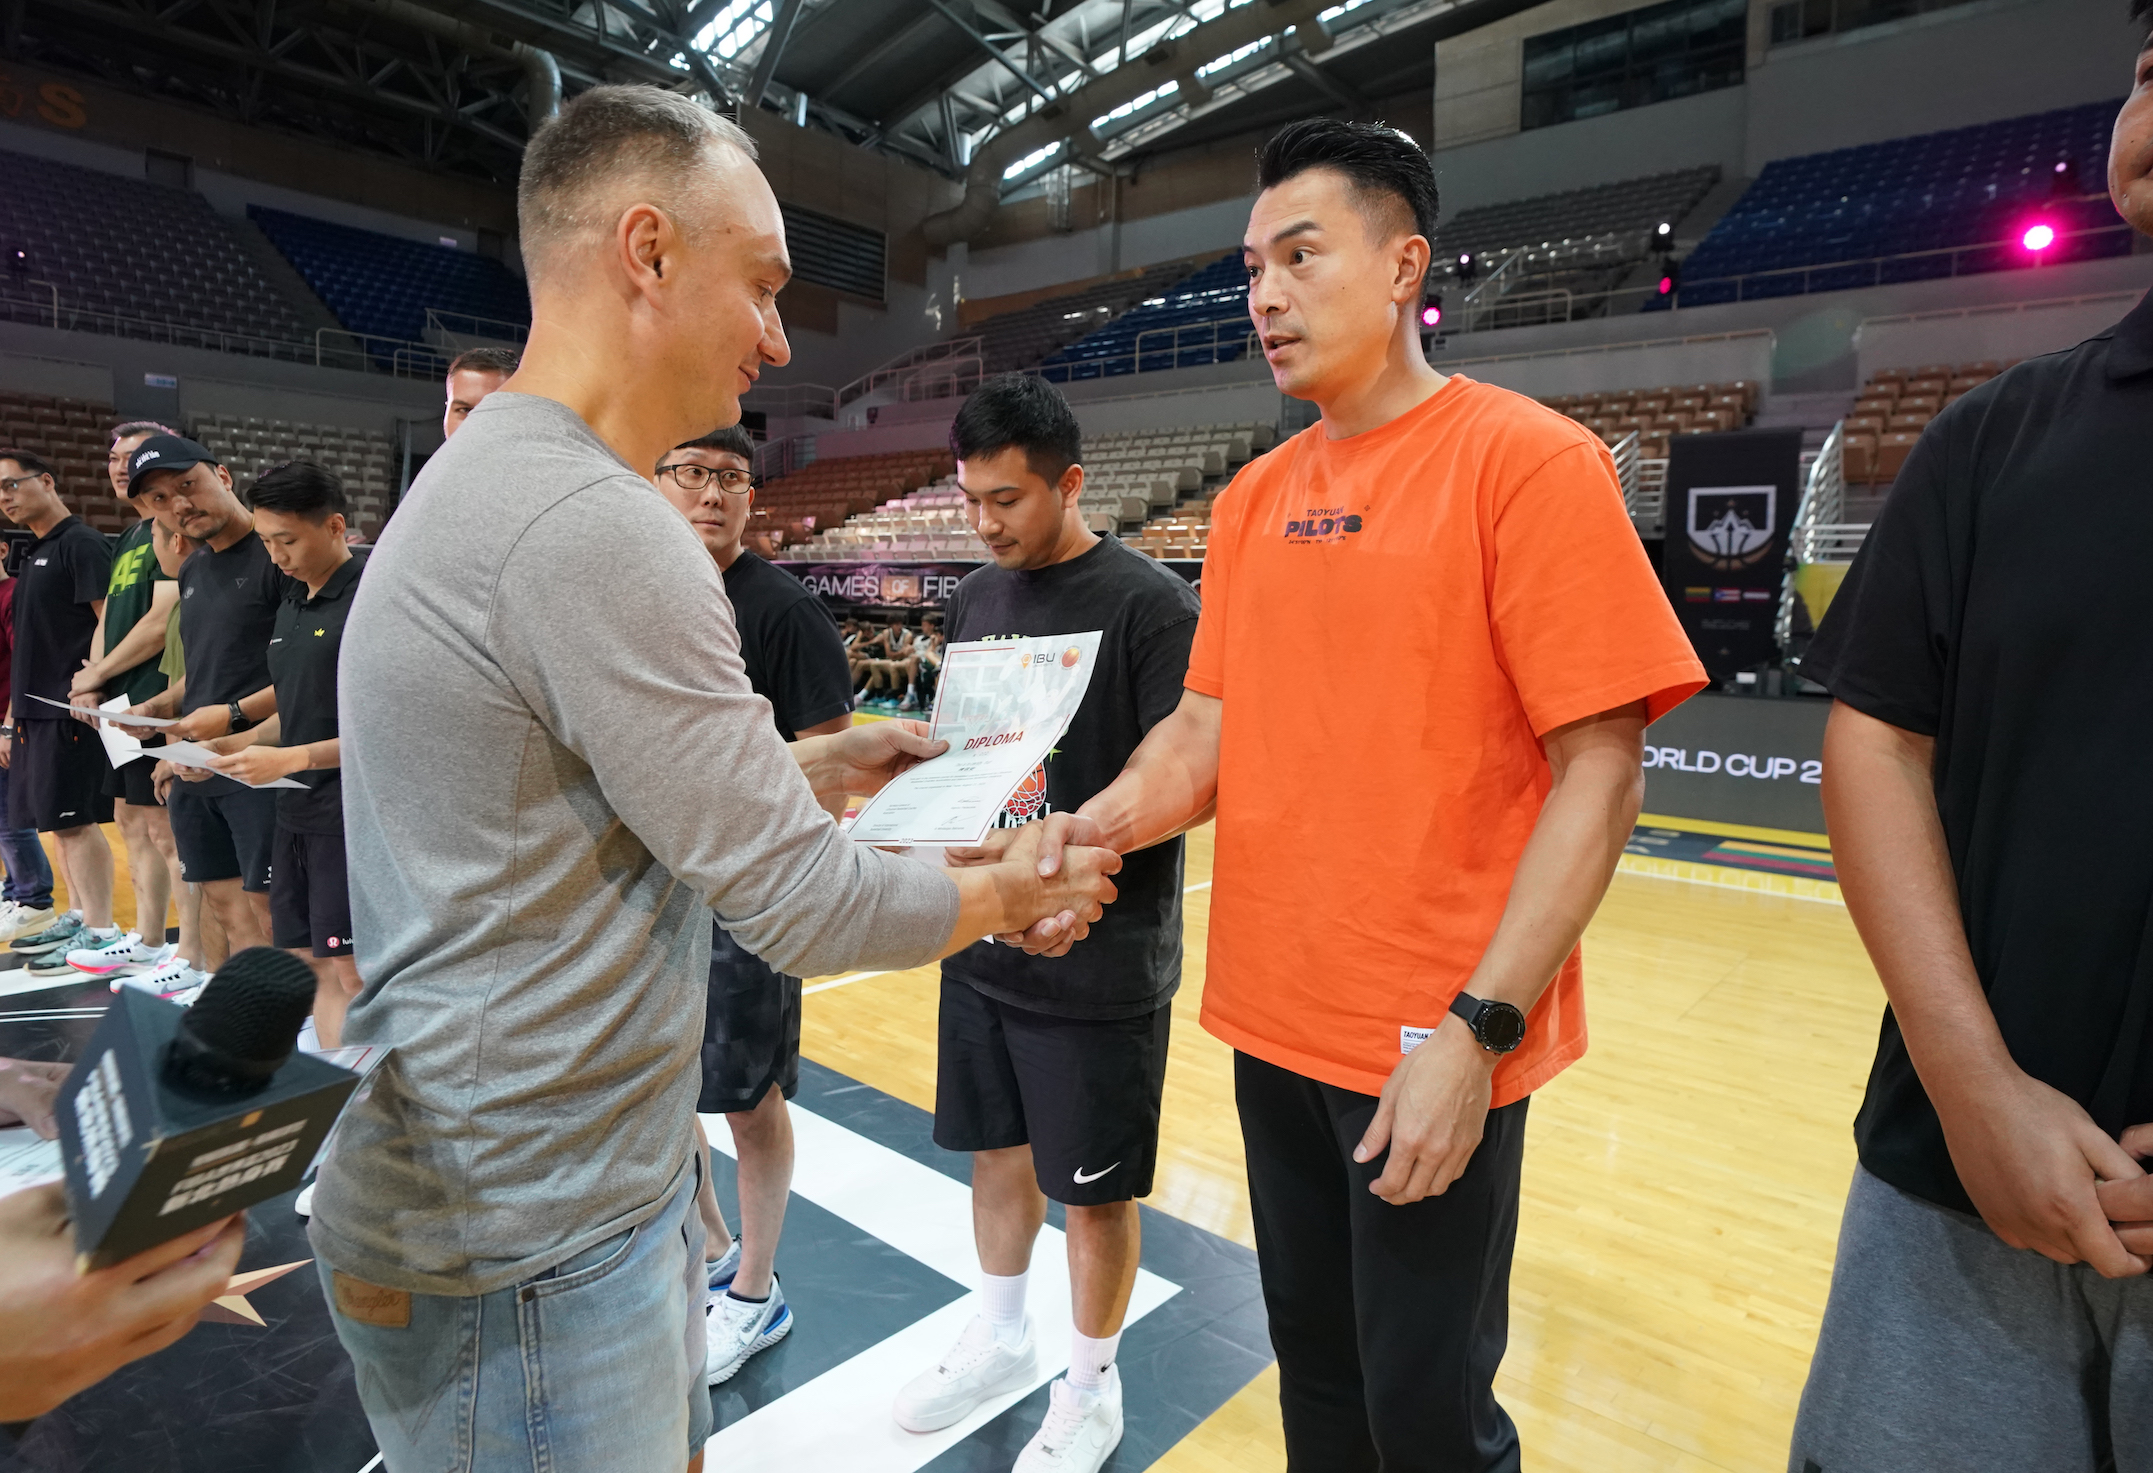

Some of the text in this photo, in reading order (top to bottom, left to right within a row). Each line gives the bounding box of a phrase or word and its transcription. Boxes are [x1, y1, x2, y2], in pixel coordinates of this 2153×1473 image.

[1284, 514, 1363, 538] PILOTS
[802, 575, 880, 598] GAMES
[891, 579, 910, 594] OF
[1033, 652, 1056, 664] IBU
[963, 731, 1024, 750] DIPLOMA
[1724, 753, 1798, 780] CUP
[1799, 760, 1822, 784] 2
